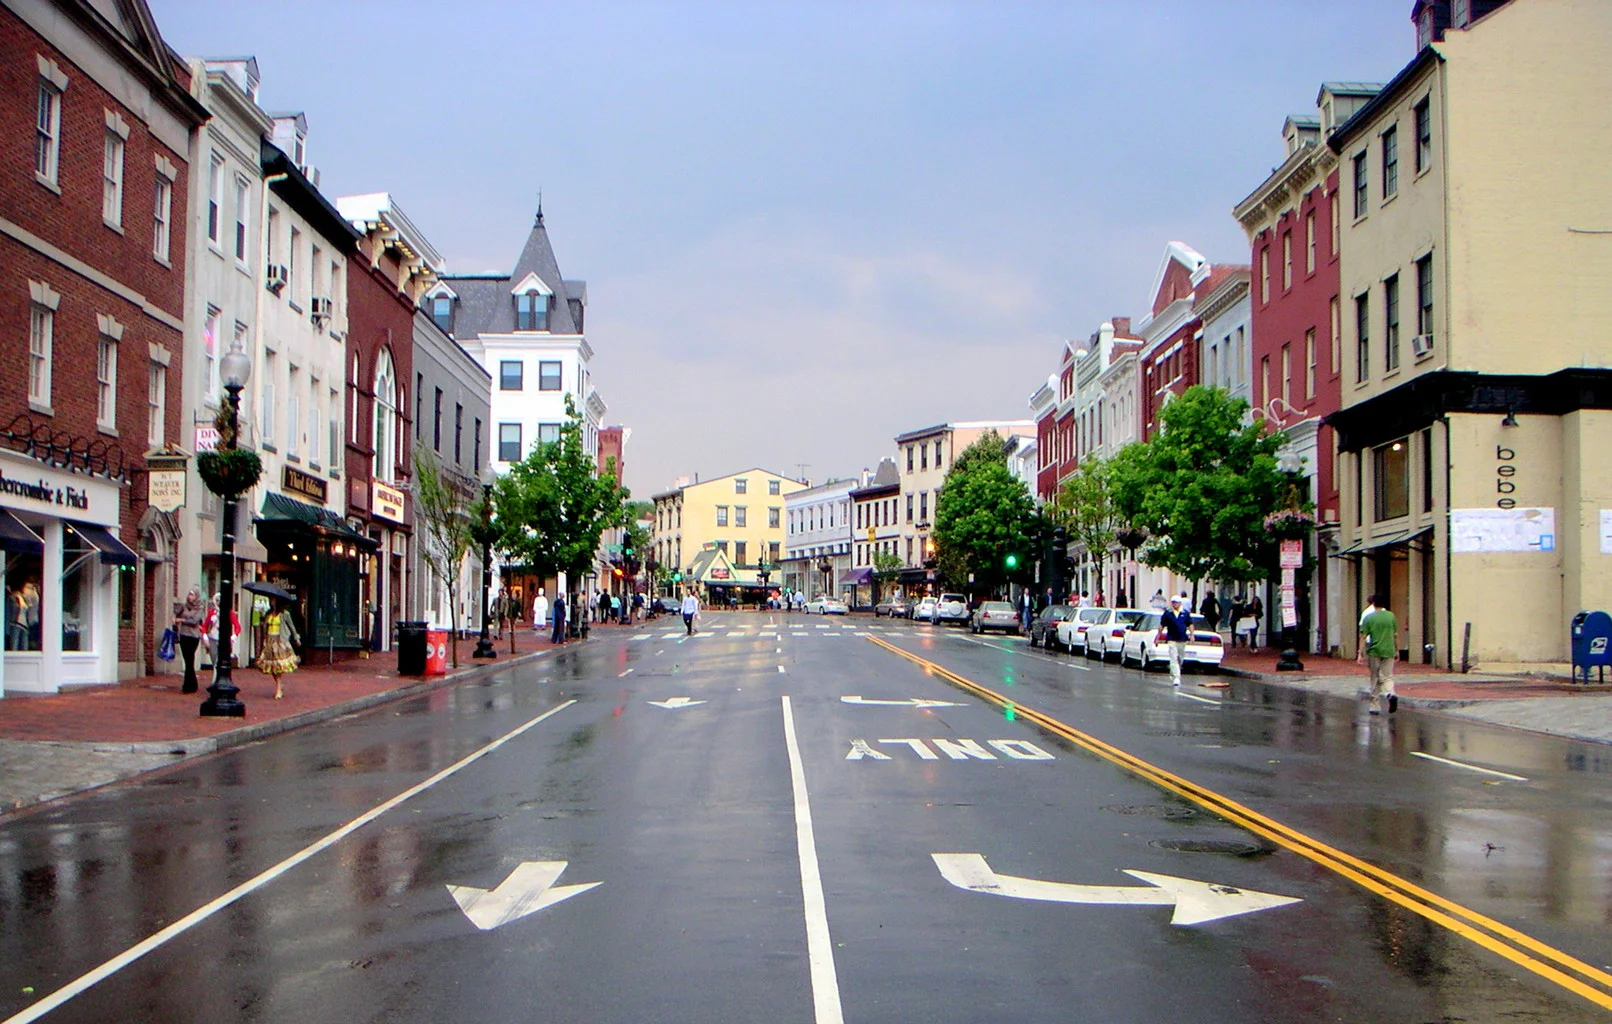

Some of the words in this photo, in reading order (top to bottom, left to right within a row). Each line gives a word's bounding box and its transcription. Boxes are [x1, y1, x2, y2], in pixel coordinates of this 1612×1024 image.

[1497, 445, 1516, 509] bebe
[66, 486, 88, 510] Fitch
[845, 738, 1056, 760] ONLY
